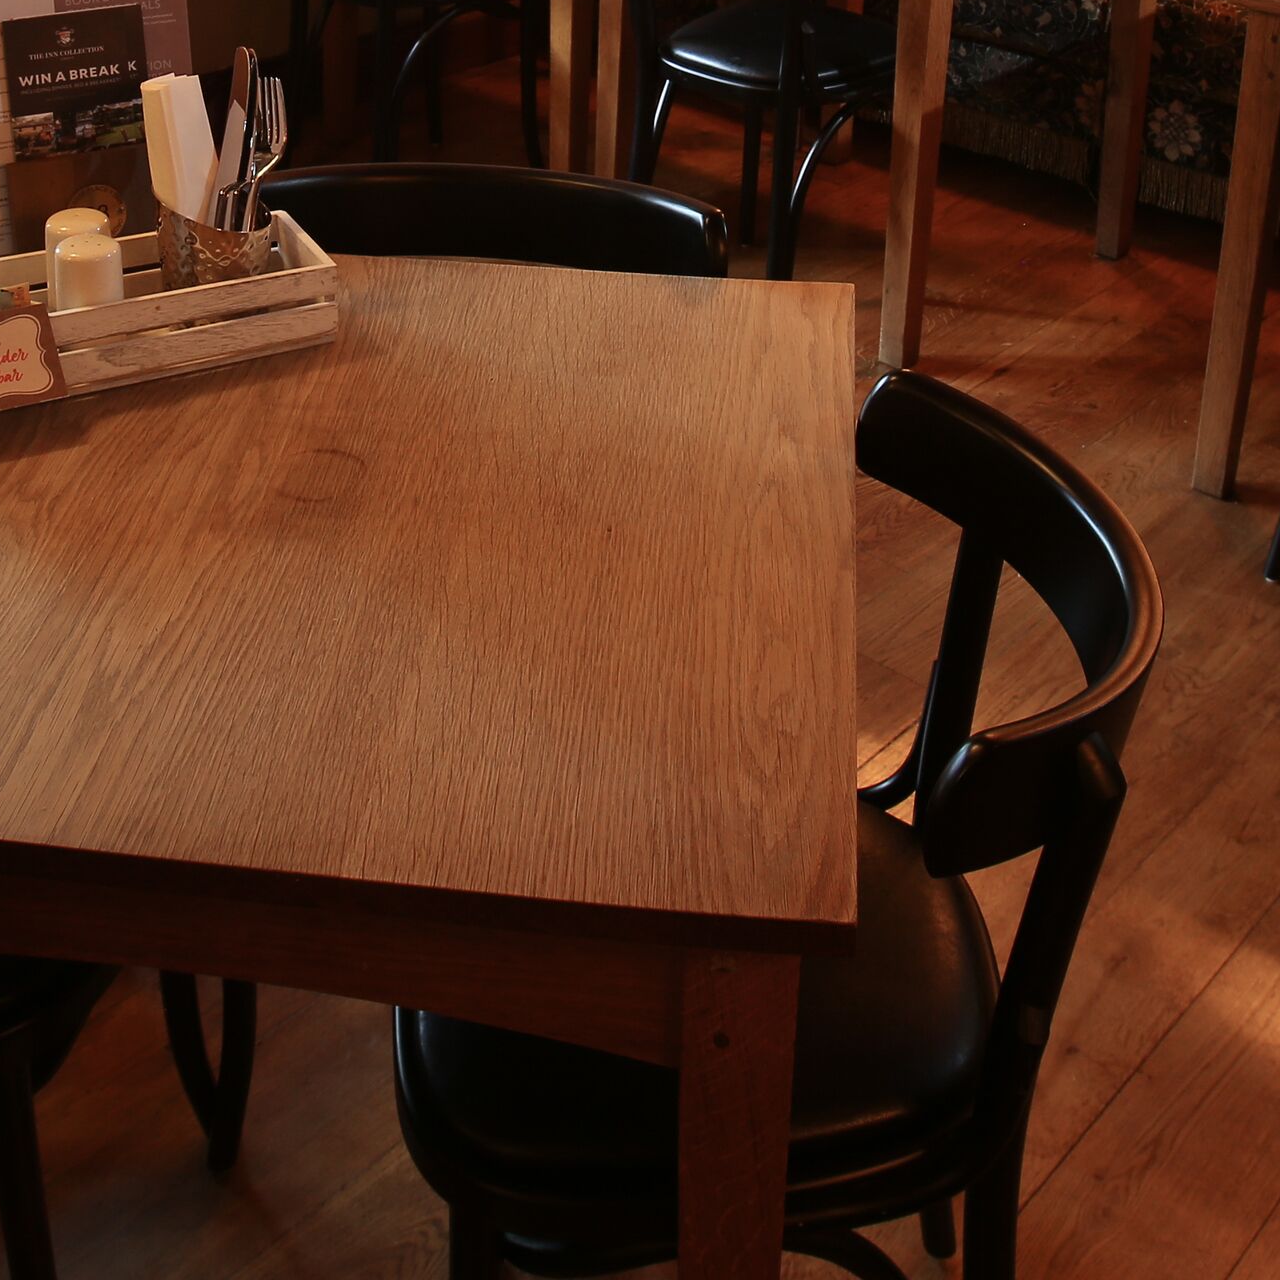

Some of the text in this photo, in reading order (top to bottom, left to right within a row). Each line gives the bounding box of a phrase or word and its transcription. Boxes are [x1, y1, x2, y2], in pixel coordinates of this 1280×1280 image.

[28, 52, 44, 61] THE
[45, 50, 59, 59] INN
[59, 45, 105, 57] COLLECTION
[18, 72, 52, 88] WIN
[55, 71, 66, 83] A
[69, 63, 120, 81] BREAK
